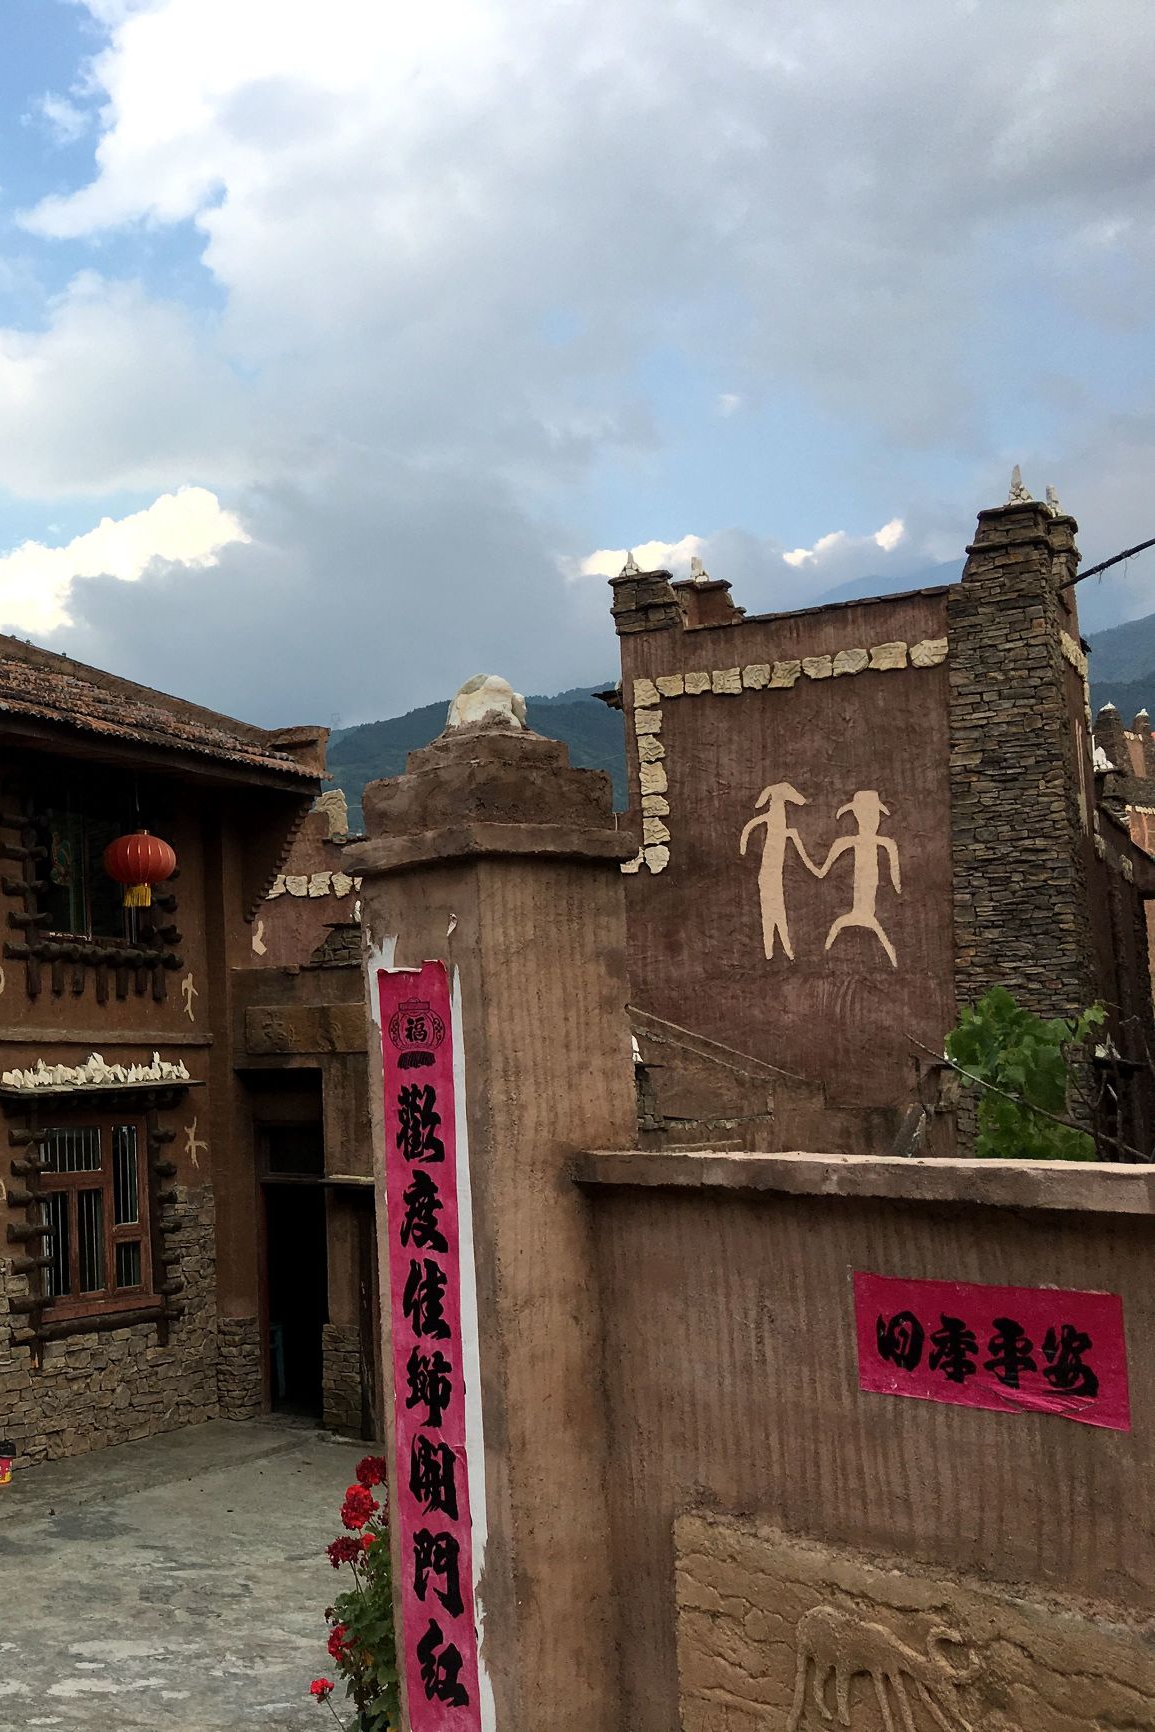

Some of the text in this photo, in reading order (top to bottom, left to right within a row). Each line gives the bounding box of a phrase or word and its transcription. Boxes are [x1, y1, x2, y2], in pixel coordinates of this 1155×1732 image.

[405, 1016, 428, 1043] 福
[875, 1310, 1100, 1398] 四季平安
